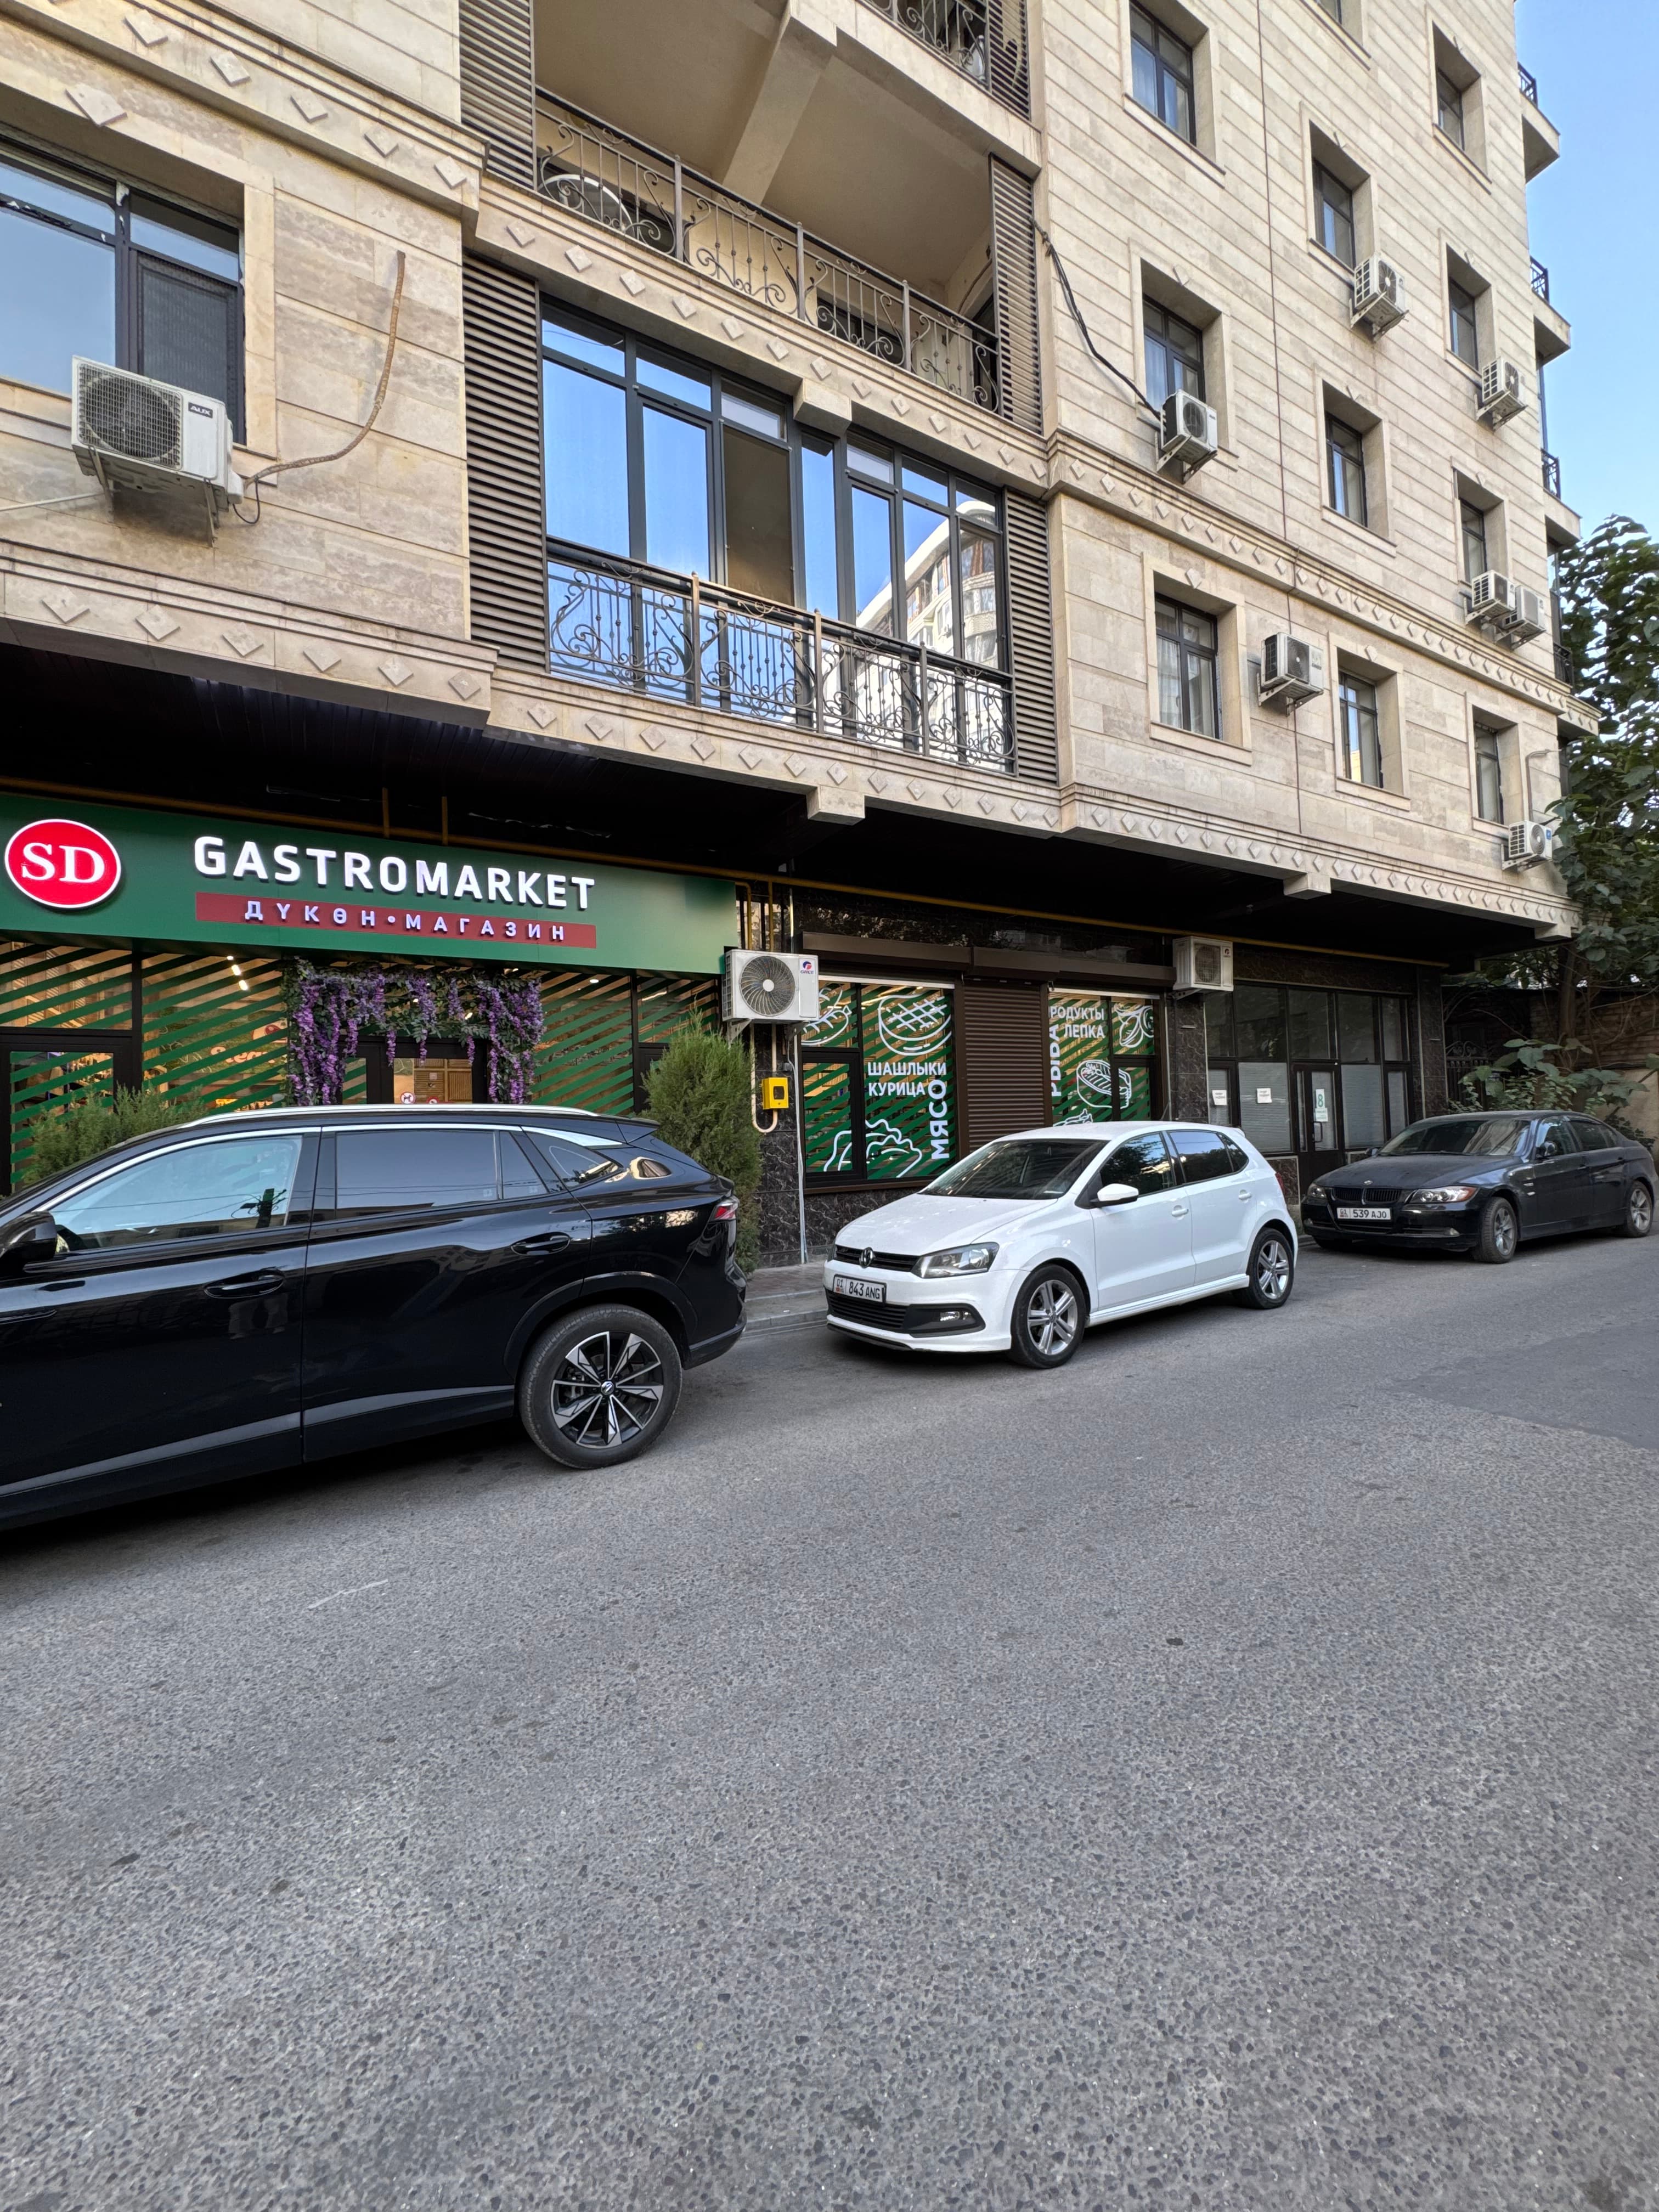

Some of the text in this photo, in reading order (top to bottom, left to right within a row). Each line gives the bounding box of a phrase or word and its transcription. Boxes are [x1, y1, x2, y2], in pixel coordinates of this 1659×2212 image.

[190, 406, 211, 416] AUX
[21, 842, 105, 883] SD
[195, 836, 595, 910] GASTROMARKET
[1064, 1024, 1105, 1038] ЛЕПКА
[868, 1062, 946, 1075] ШАШЛЫКИ
[868, 1082, 926, 1097] КУРИЦА
[1318, 1093, 1324, 1107] 8
[928, 1080, 950, 1159] МЯСО
[1353, 1209, 1369, 1218] 539
[837, 1279, 880, 1299] 01 843 ANG
